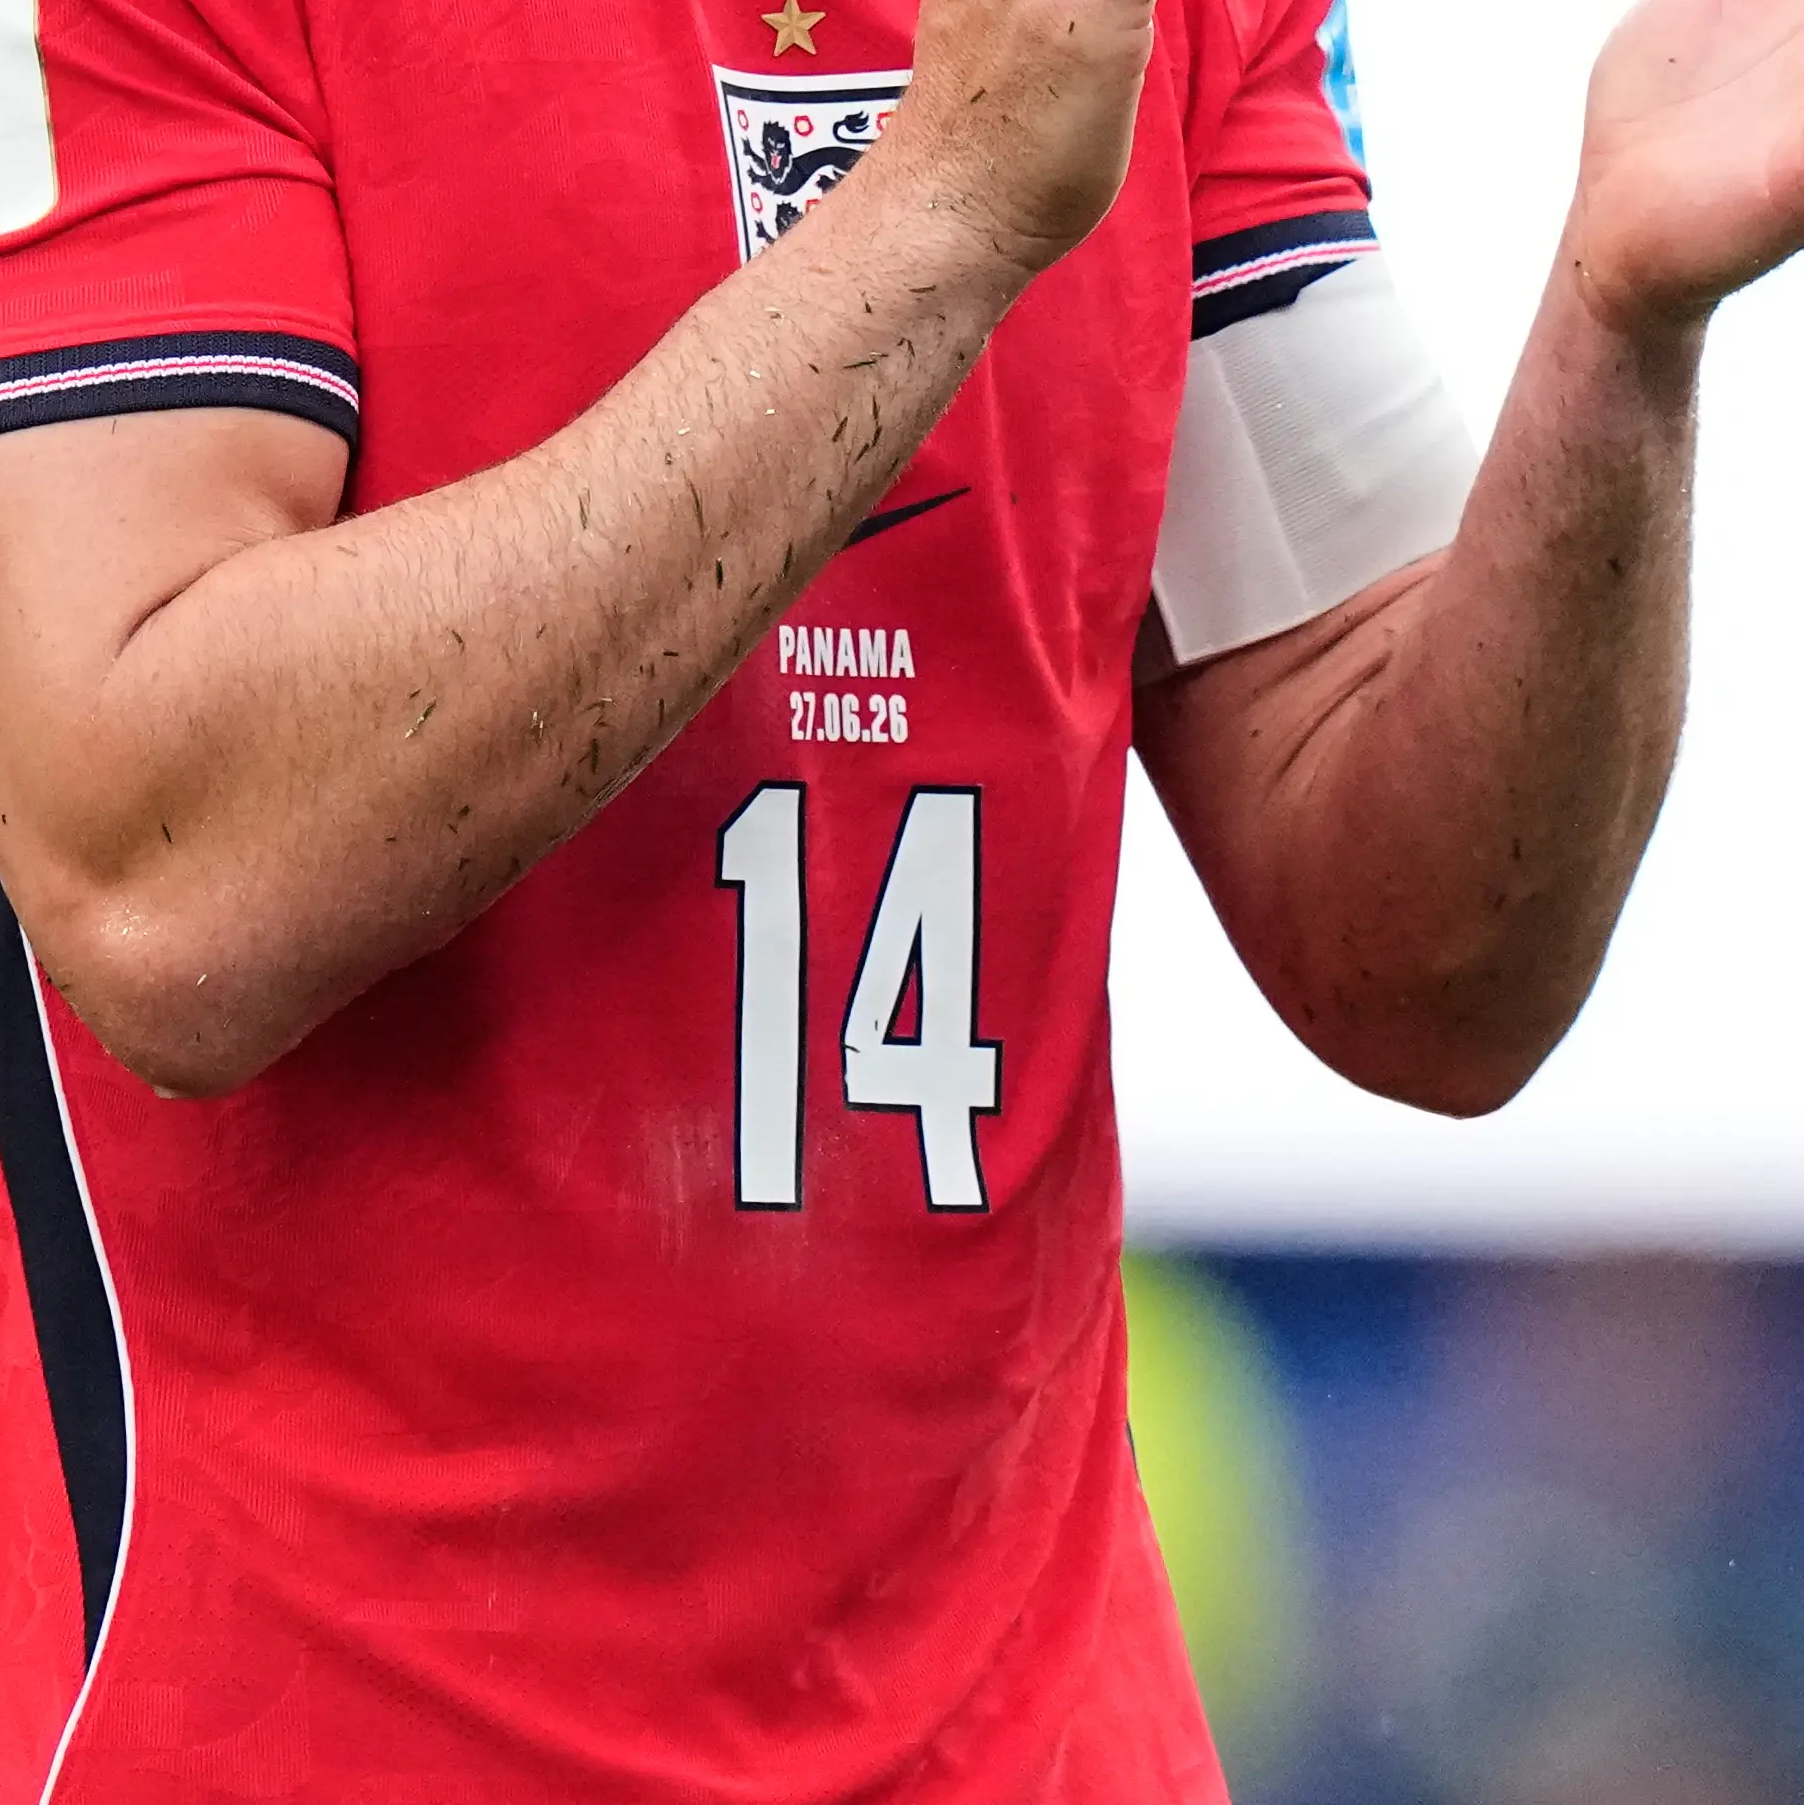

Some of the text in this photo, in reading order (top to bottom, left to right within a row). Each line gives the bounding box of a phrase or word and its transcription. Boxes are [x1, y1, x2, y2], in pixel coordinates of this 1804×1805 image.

[778, 624, 916, 678] PANAMA
[789, 690, 909, 744] 27.06.26
[715, 779, 1003, 1213] 14
